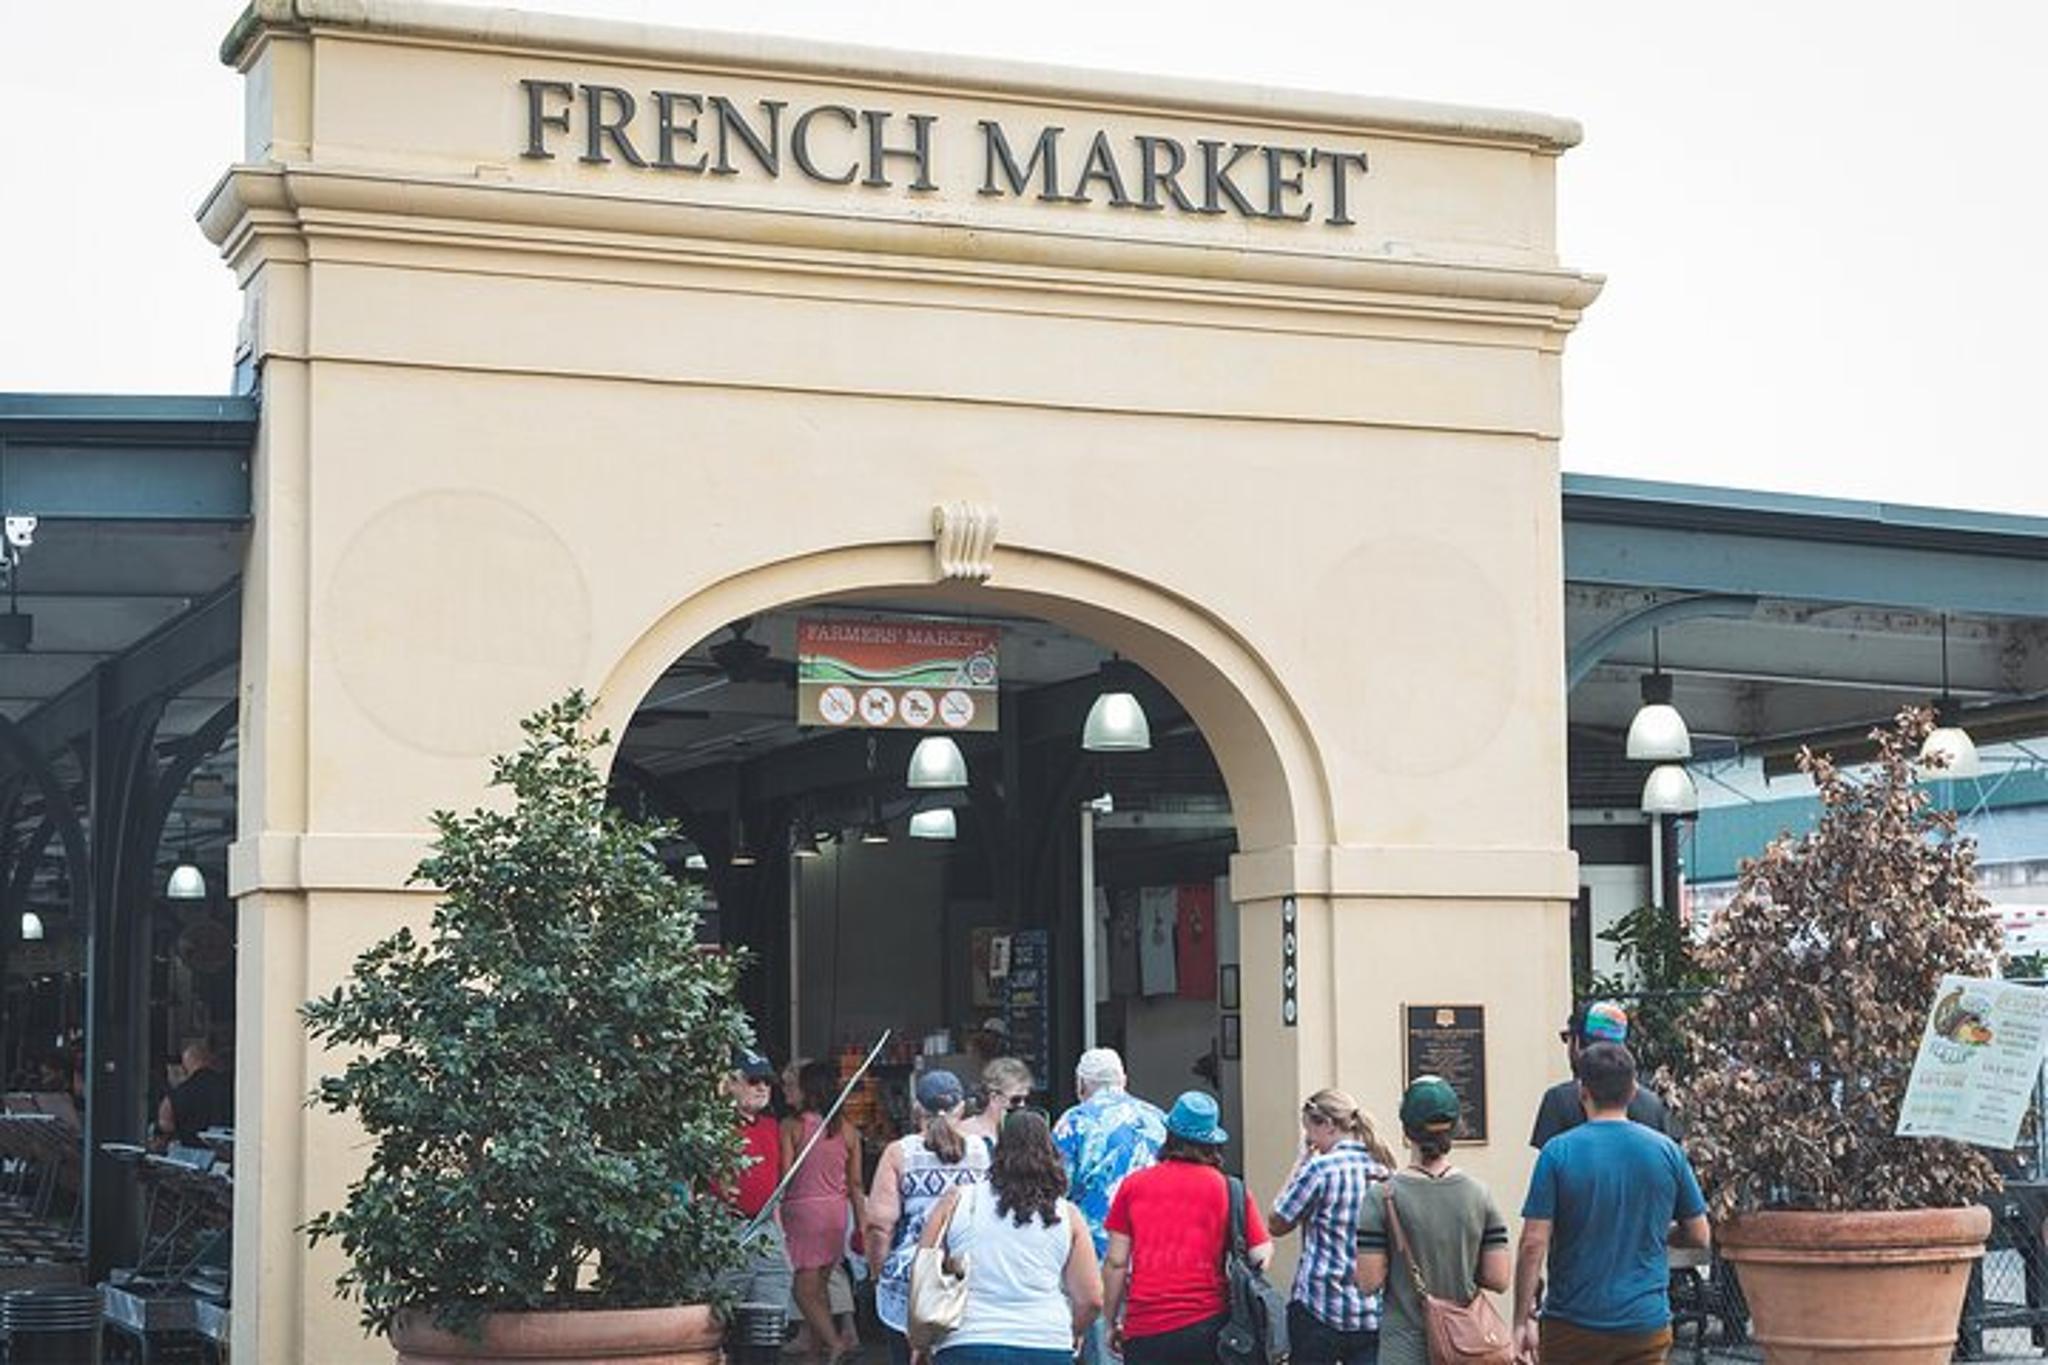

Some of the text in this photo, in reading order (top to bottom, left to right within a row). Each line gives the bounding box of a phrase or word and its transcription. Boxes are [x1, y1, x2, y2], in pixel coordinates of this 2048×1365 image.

[520, 79, 1368, 227] FRENCH MARKET
[806, 624, 985, 647] FARMERS' MARKET
